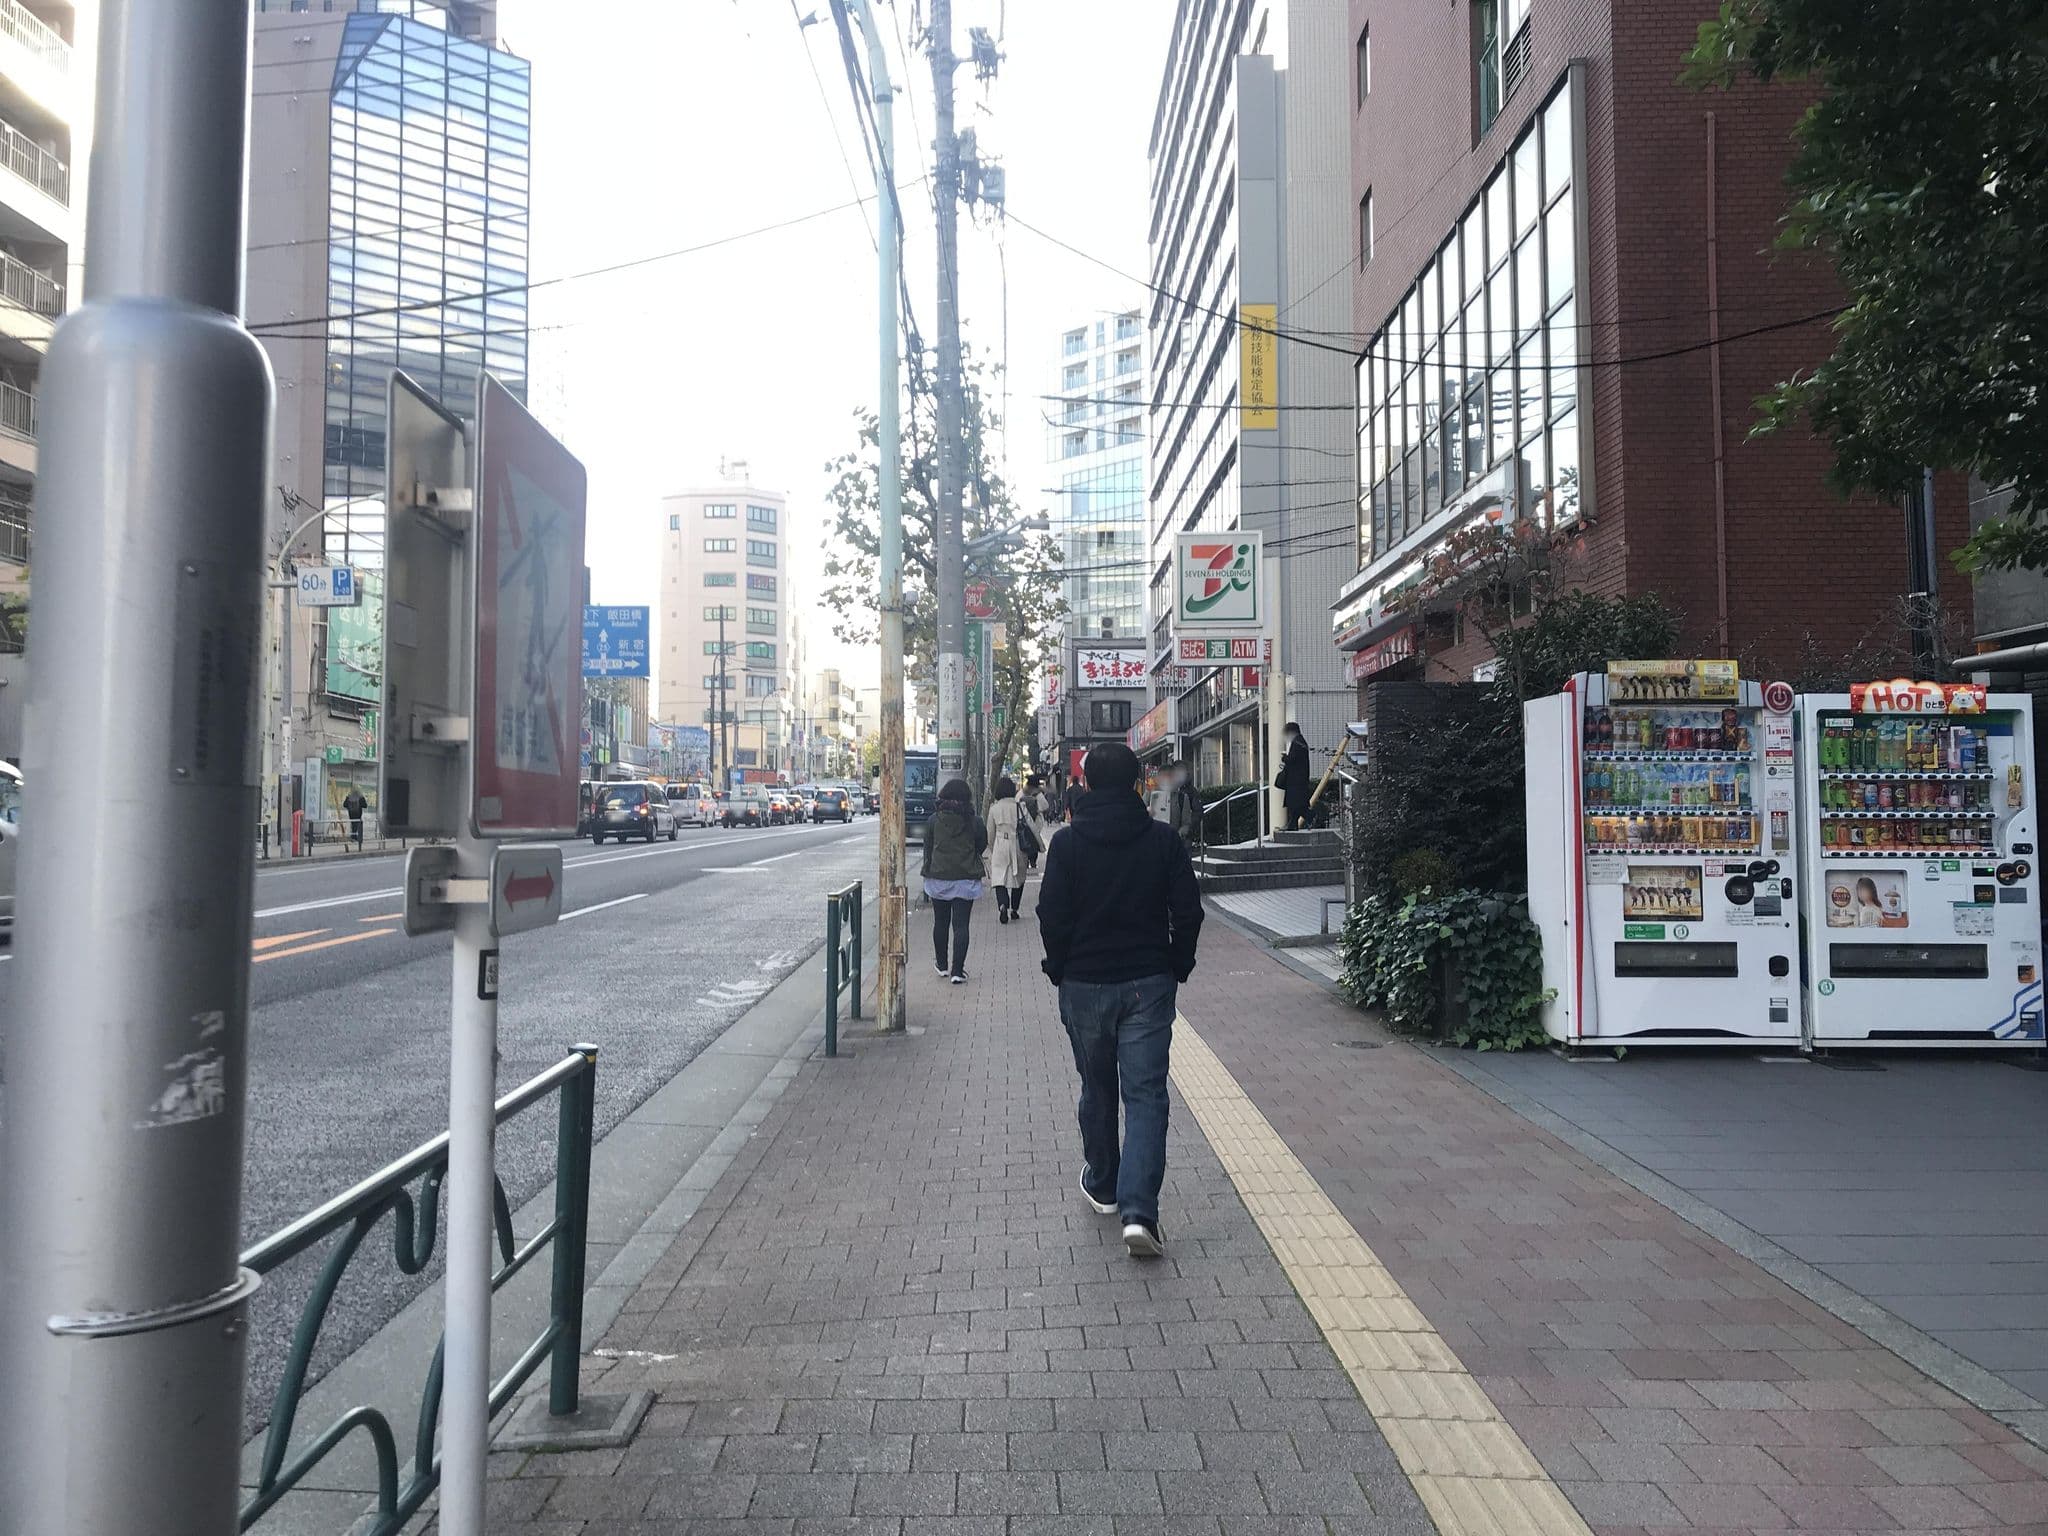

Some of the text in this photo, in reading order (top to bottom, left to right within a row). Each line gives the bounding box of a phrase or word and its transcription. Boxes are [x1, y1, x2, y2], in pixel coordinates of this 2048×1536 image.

[337, 570, 348, 586] P
[1216, 569, 1252, 578] HOLDINGS
[1181, 642, 1205, 658] たばこ
[1211, 641, 1226, 657] 酒
[1233, 641, 1256, 657] ATM
